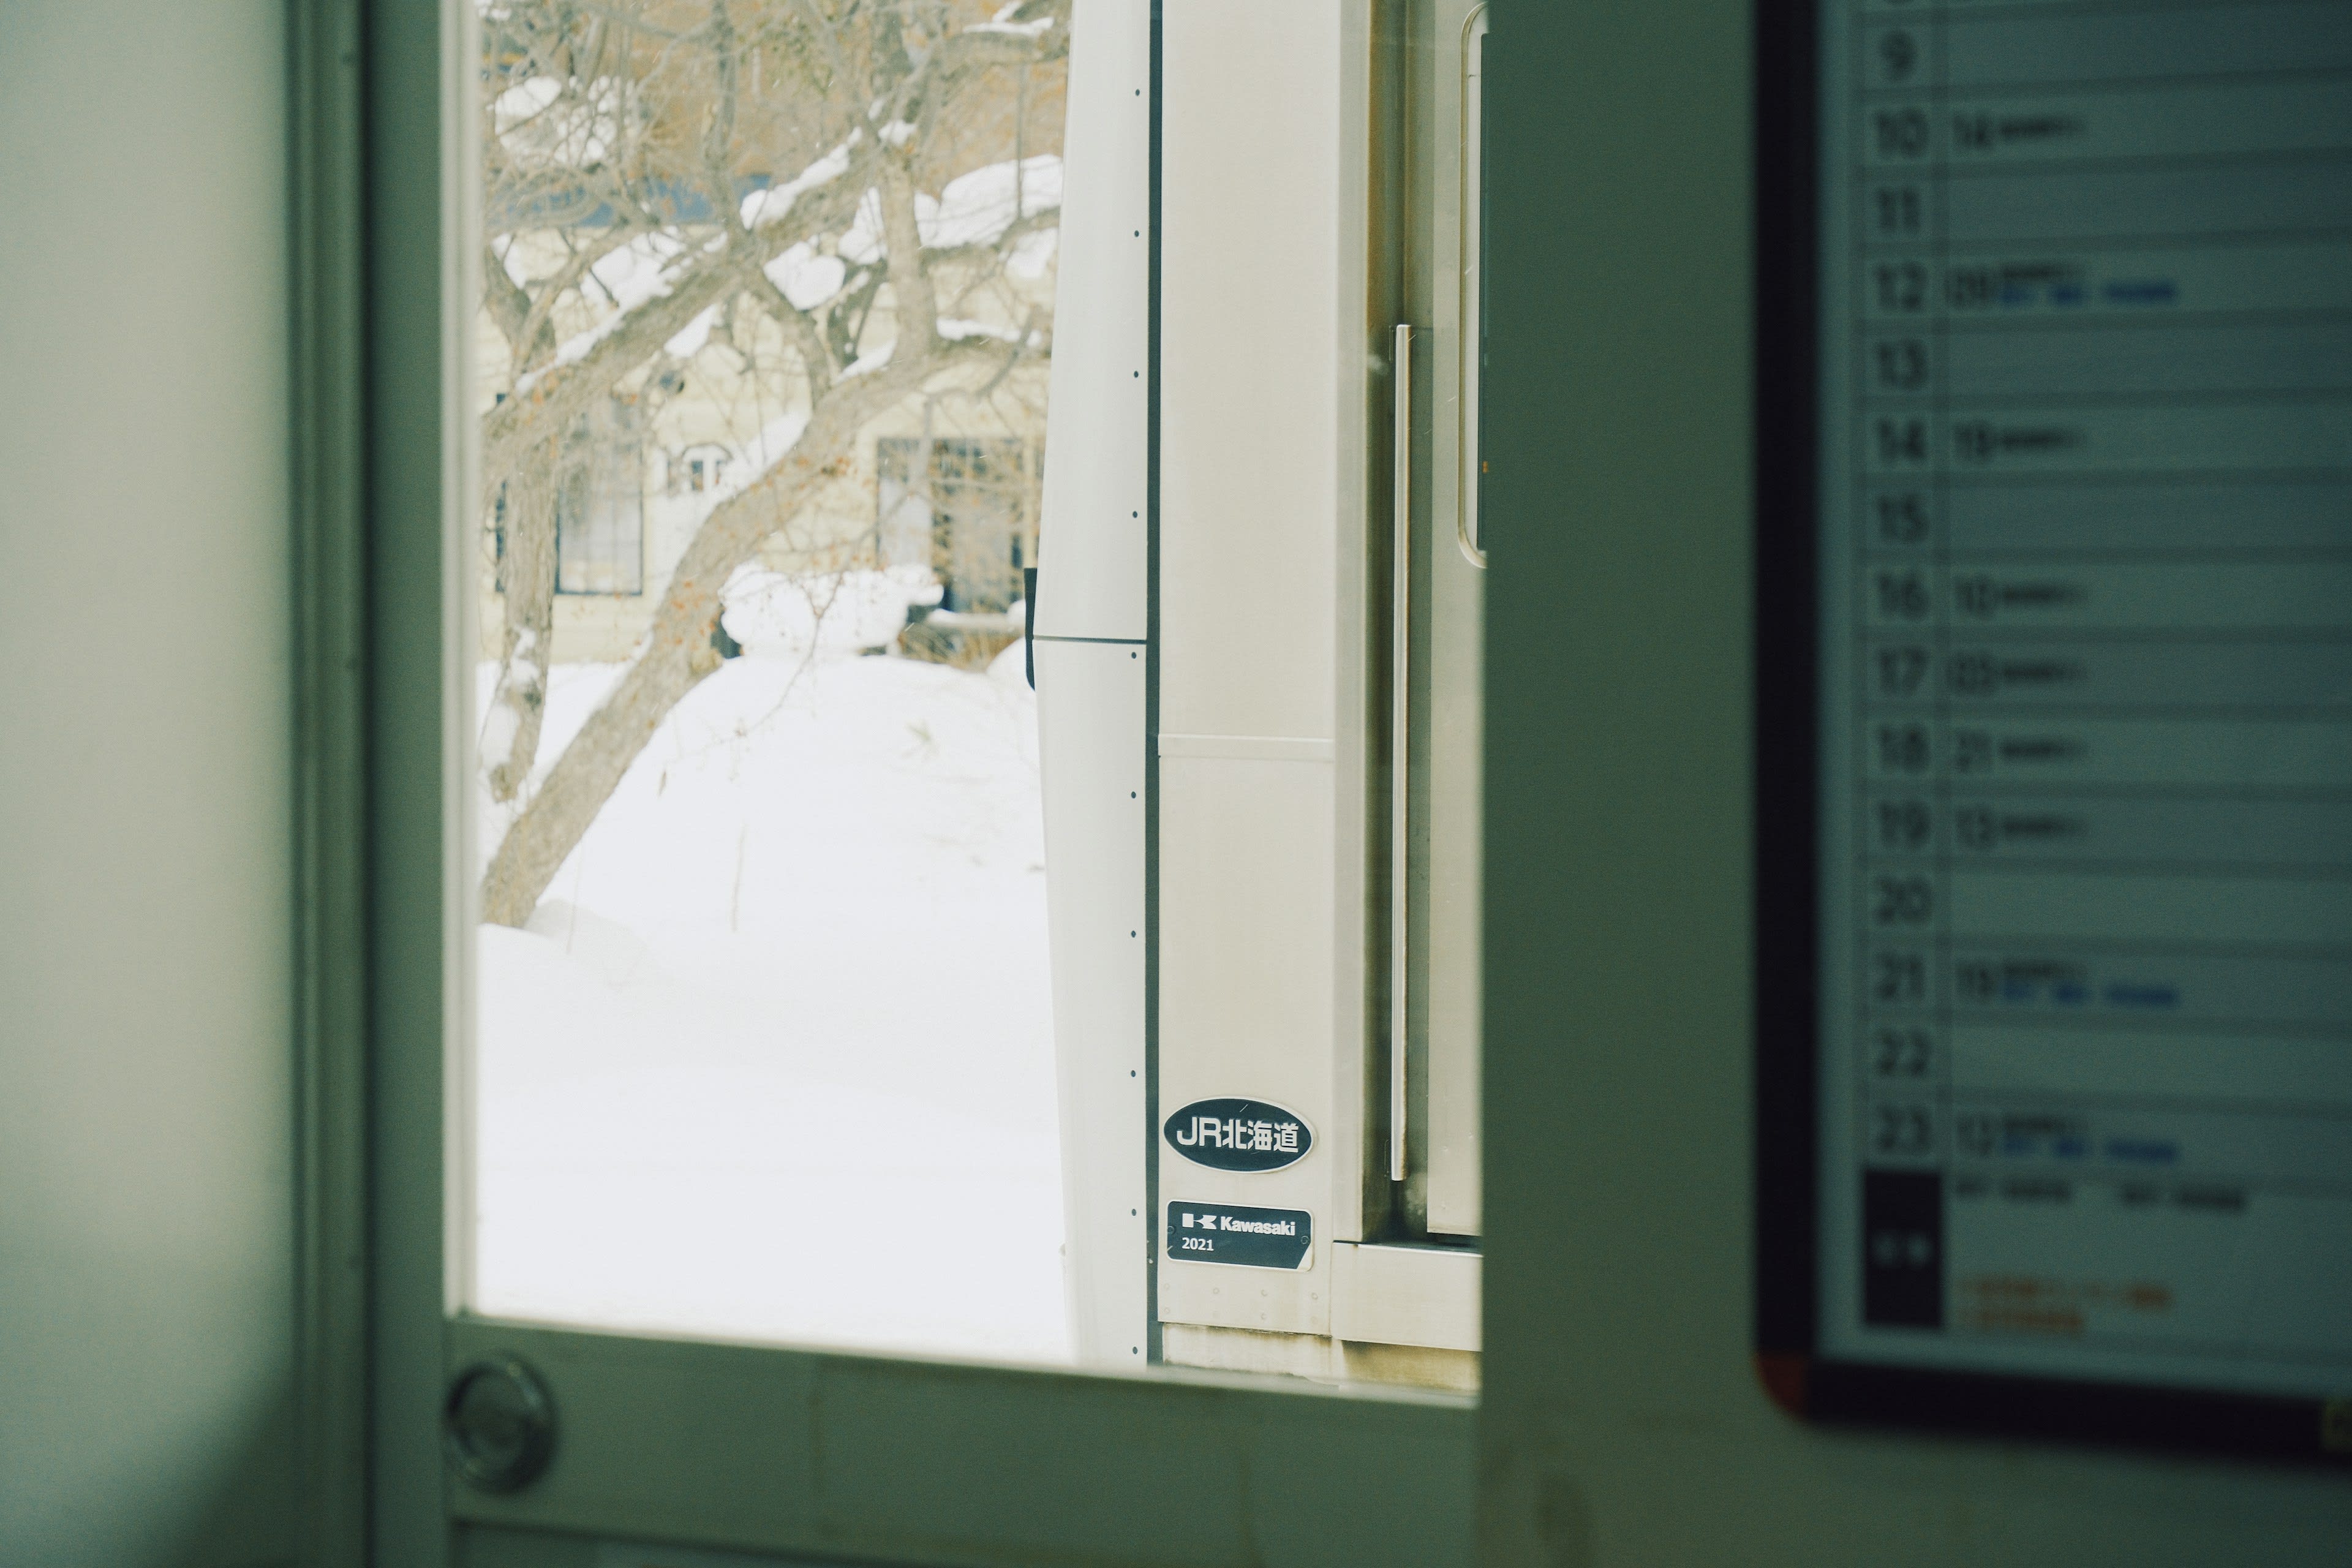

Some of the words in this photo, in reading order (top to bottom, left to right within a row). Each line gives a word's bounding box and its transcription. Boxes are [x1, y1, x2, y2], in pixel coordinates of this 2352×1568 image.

[1875, 108, 1928, 159] 10
[1877, 186, 1920, 235] 11
[1875, 262, 1928, 311] 12
[1877, 339, 1927, 391] 13
[1877, 419, 1926, 464] 14
[1877, 493, 1928, 543] 15
[1877, 571, 1929, 620] 16
[1878, 646, 1928, 696] 17
[1879, 723, 1931, 773] 18
[1879, 801, 1931, 851] 19
[1875, 876, 1933, 926] 20
[1875, 951, 1923, 1001] 21
[1875, 1028, 1931, 1078] 22
[1177, 1117, 1298, 1153] JR北海道
[1877, 1104, 1931, 1155] 23
[1182, 1237, 1214, 1251] 2021
[1220, 1216, 1295, 1236] Kawasaki
